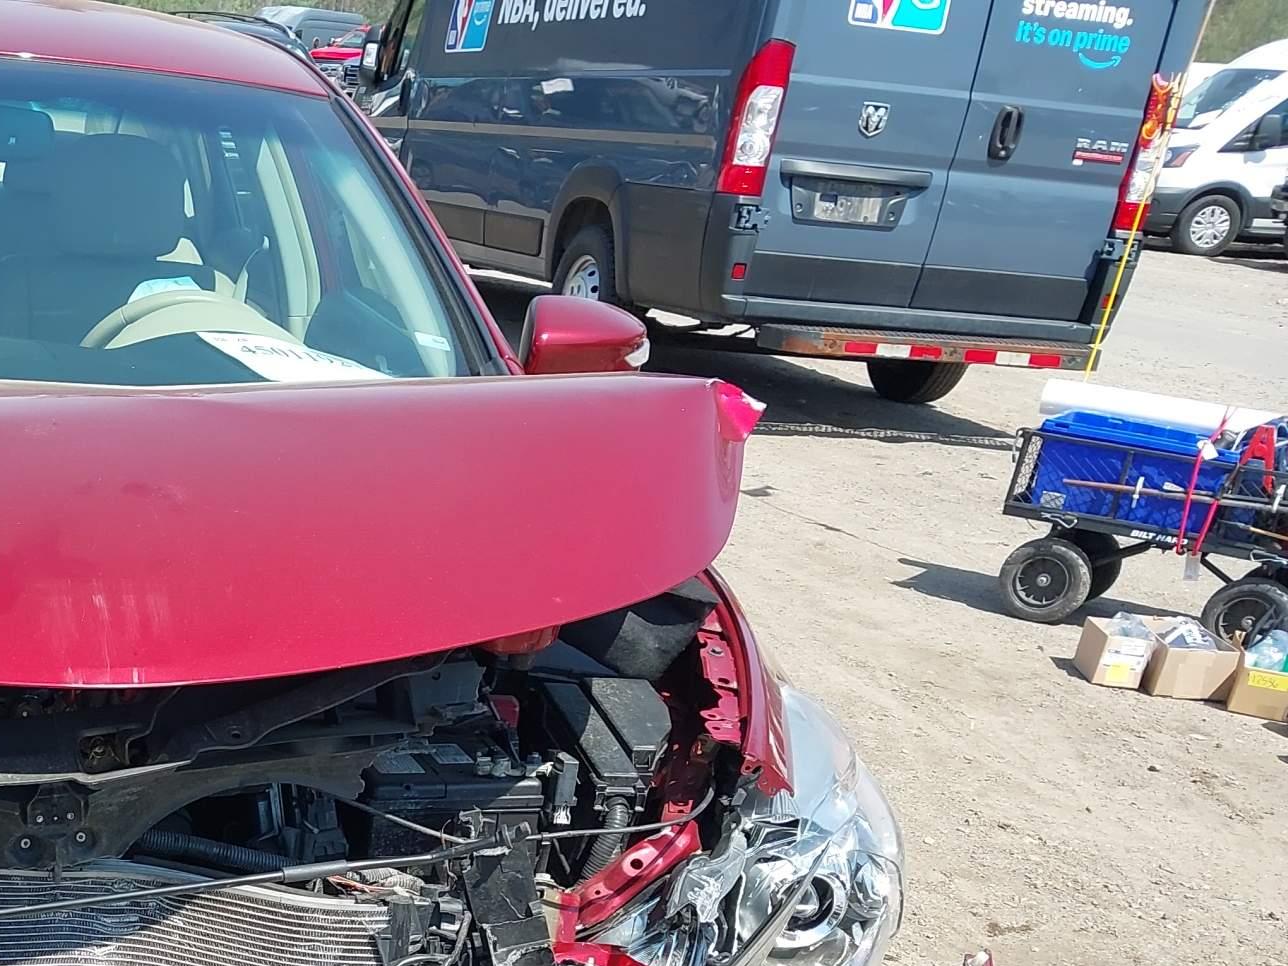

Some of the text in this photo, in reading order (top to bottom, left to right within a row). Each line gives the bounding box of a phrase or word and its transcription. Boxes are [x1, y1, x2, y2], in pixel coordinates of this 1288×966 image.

[497, 0, 539, 31] NBA,
[1021, 0, 1134, 29] streaming.
[1047, 28, 1072, 47] on
[1072, 29, 1131, 53] prime
[1076, 137, 1129, 153] RAM
[1130, 529, 1157, 540] BILT
